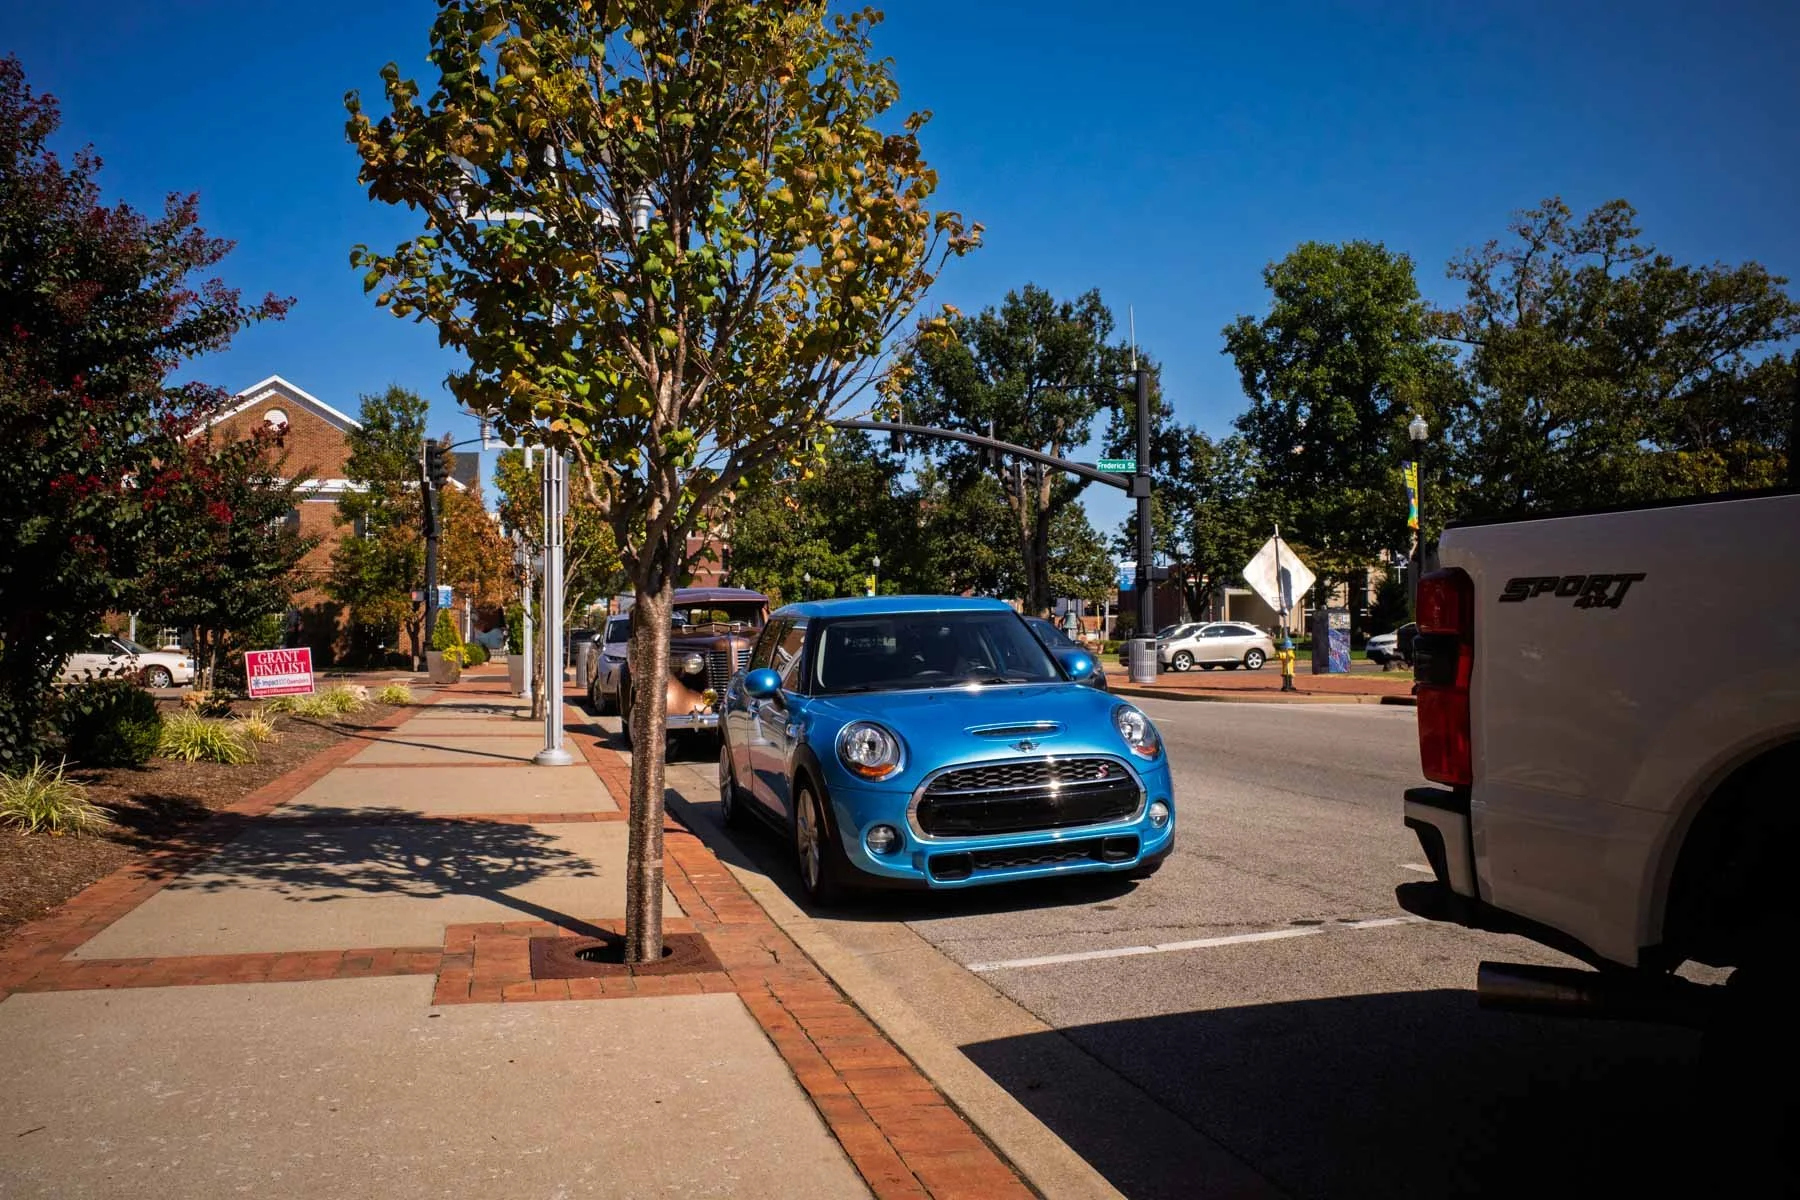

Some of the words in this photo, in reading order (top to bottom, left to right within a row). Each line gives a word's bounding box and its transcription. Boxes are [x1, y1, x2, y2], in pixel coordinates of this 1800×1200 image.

[1098, 462, 1126, 470] Frederica
[1498, 573, 1648, 607] SPORT
[257, 650, 299, 664] GRANT
[252, 661, 306, 676] FINALIST
